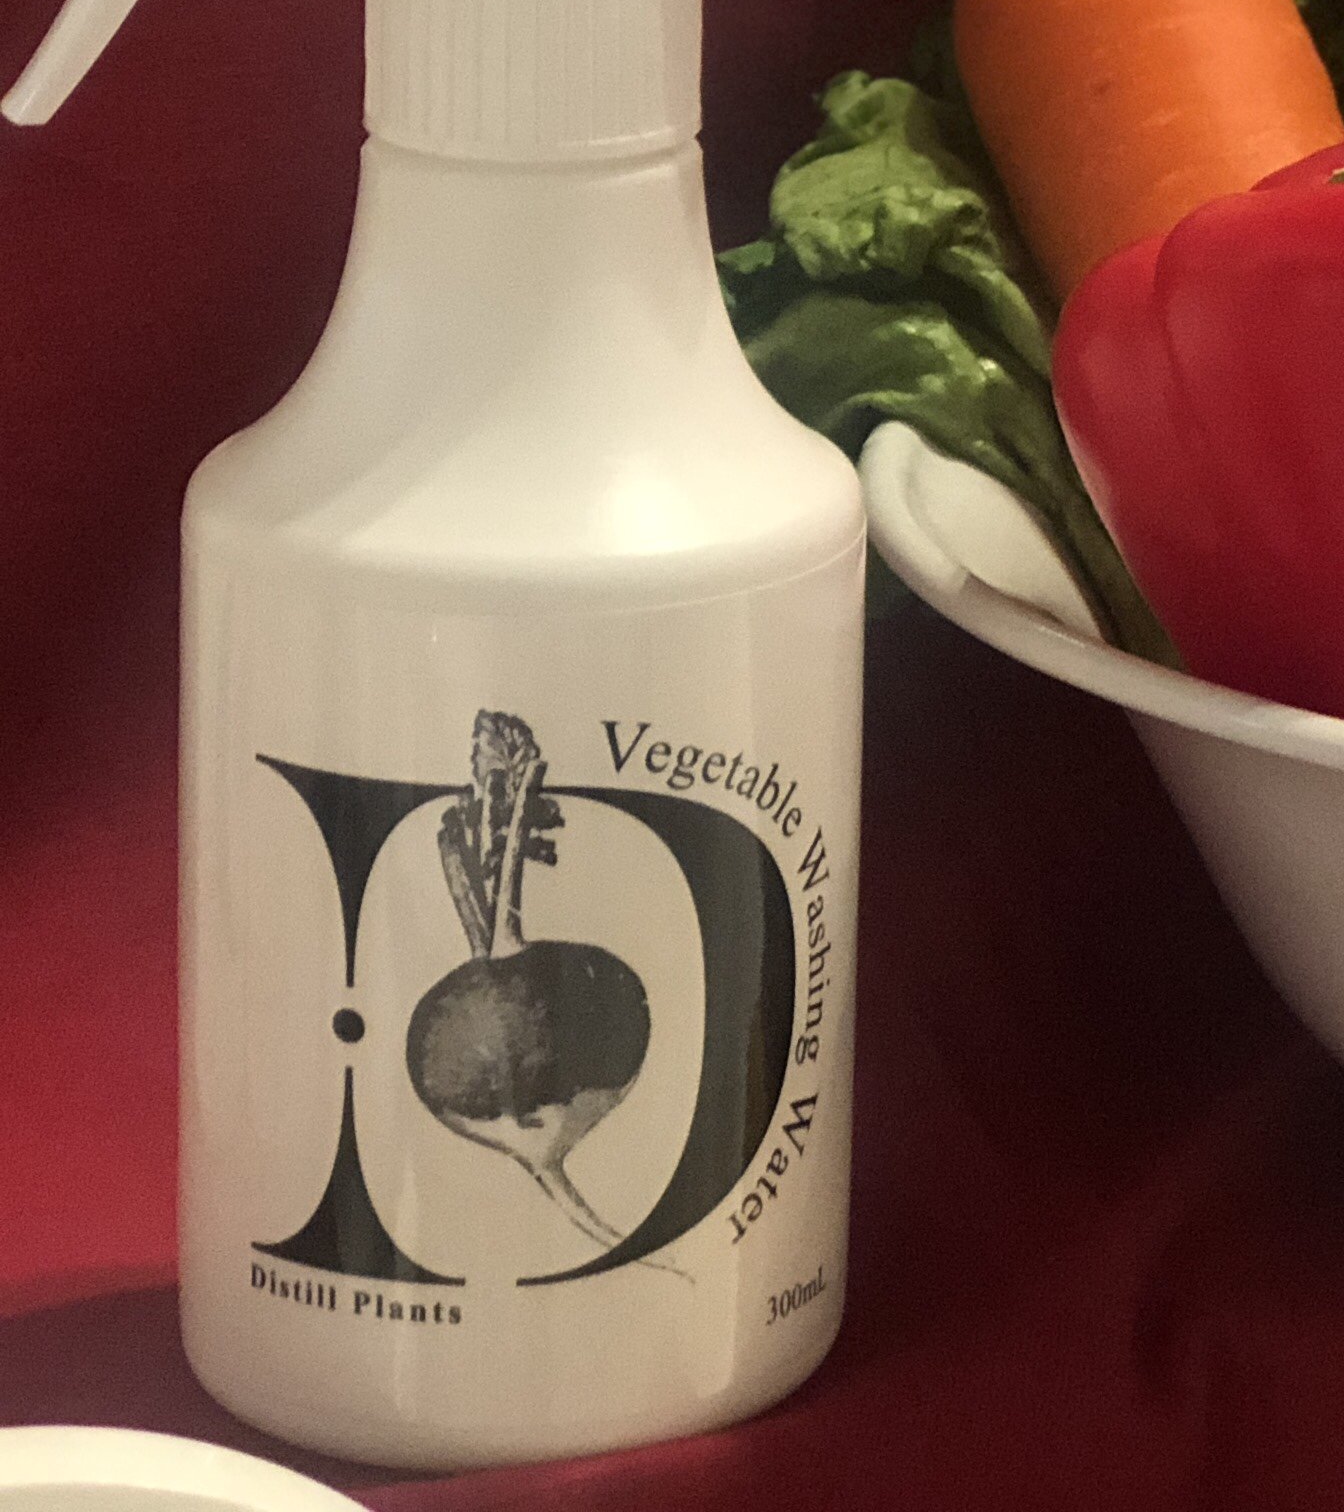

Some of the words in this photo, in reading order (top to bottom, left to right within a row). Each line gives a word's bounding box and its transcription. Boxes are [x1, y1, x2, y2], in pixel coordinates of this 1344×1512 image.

[601, 720, 803, 838] Vegetable
[795, 825, 832, 1065] Washing
[727, 1092, 819, 1246] Water
[251, 1261, 337, 1312] Distill
[354, 1290, 462, 1326] Plants
